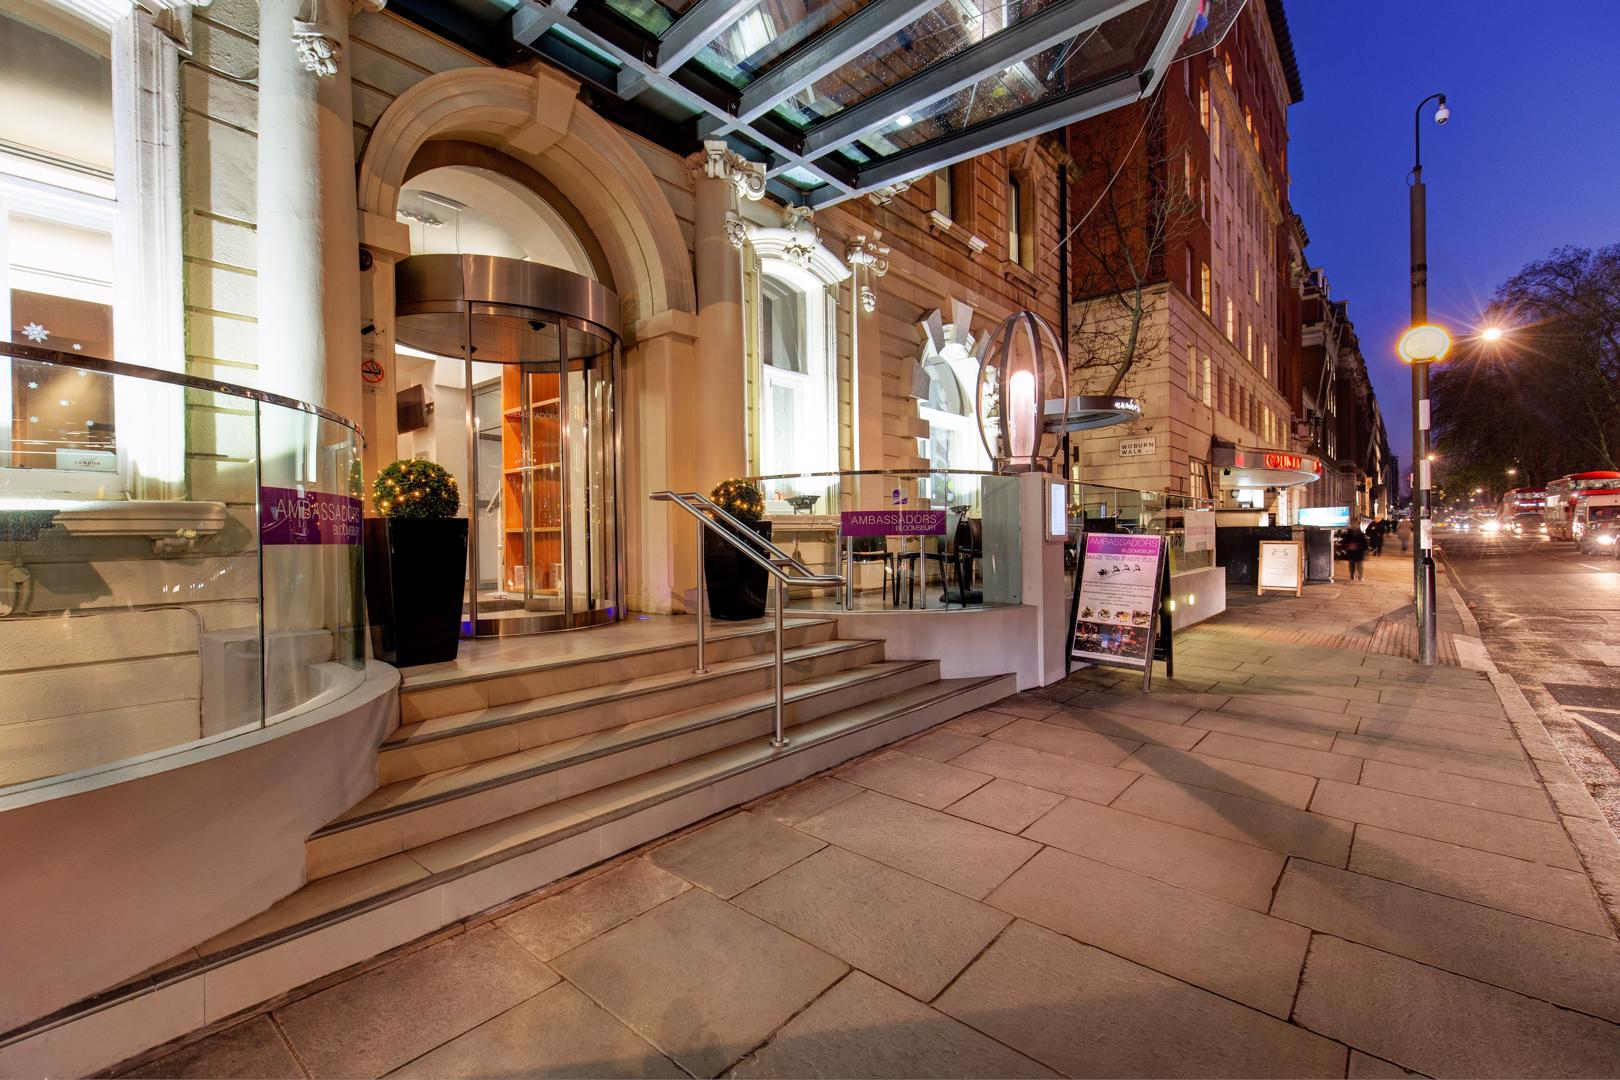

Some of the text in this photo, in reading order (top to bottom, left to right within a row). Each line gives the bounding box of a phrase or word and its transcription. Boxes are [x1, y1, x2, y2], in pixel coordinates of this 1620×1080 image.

[1121, 441, 1154, 450] WOBURN
[275, 498, 361, 524] AMBASSADORS
[850, 514, 937, 525] AMBASSADORS
[895, 524, 937, 532] BLOOMSBURY
[1089, 537, 1158, 547] AMBASSADORS
